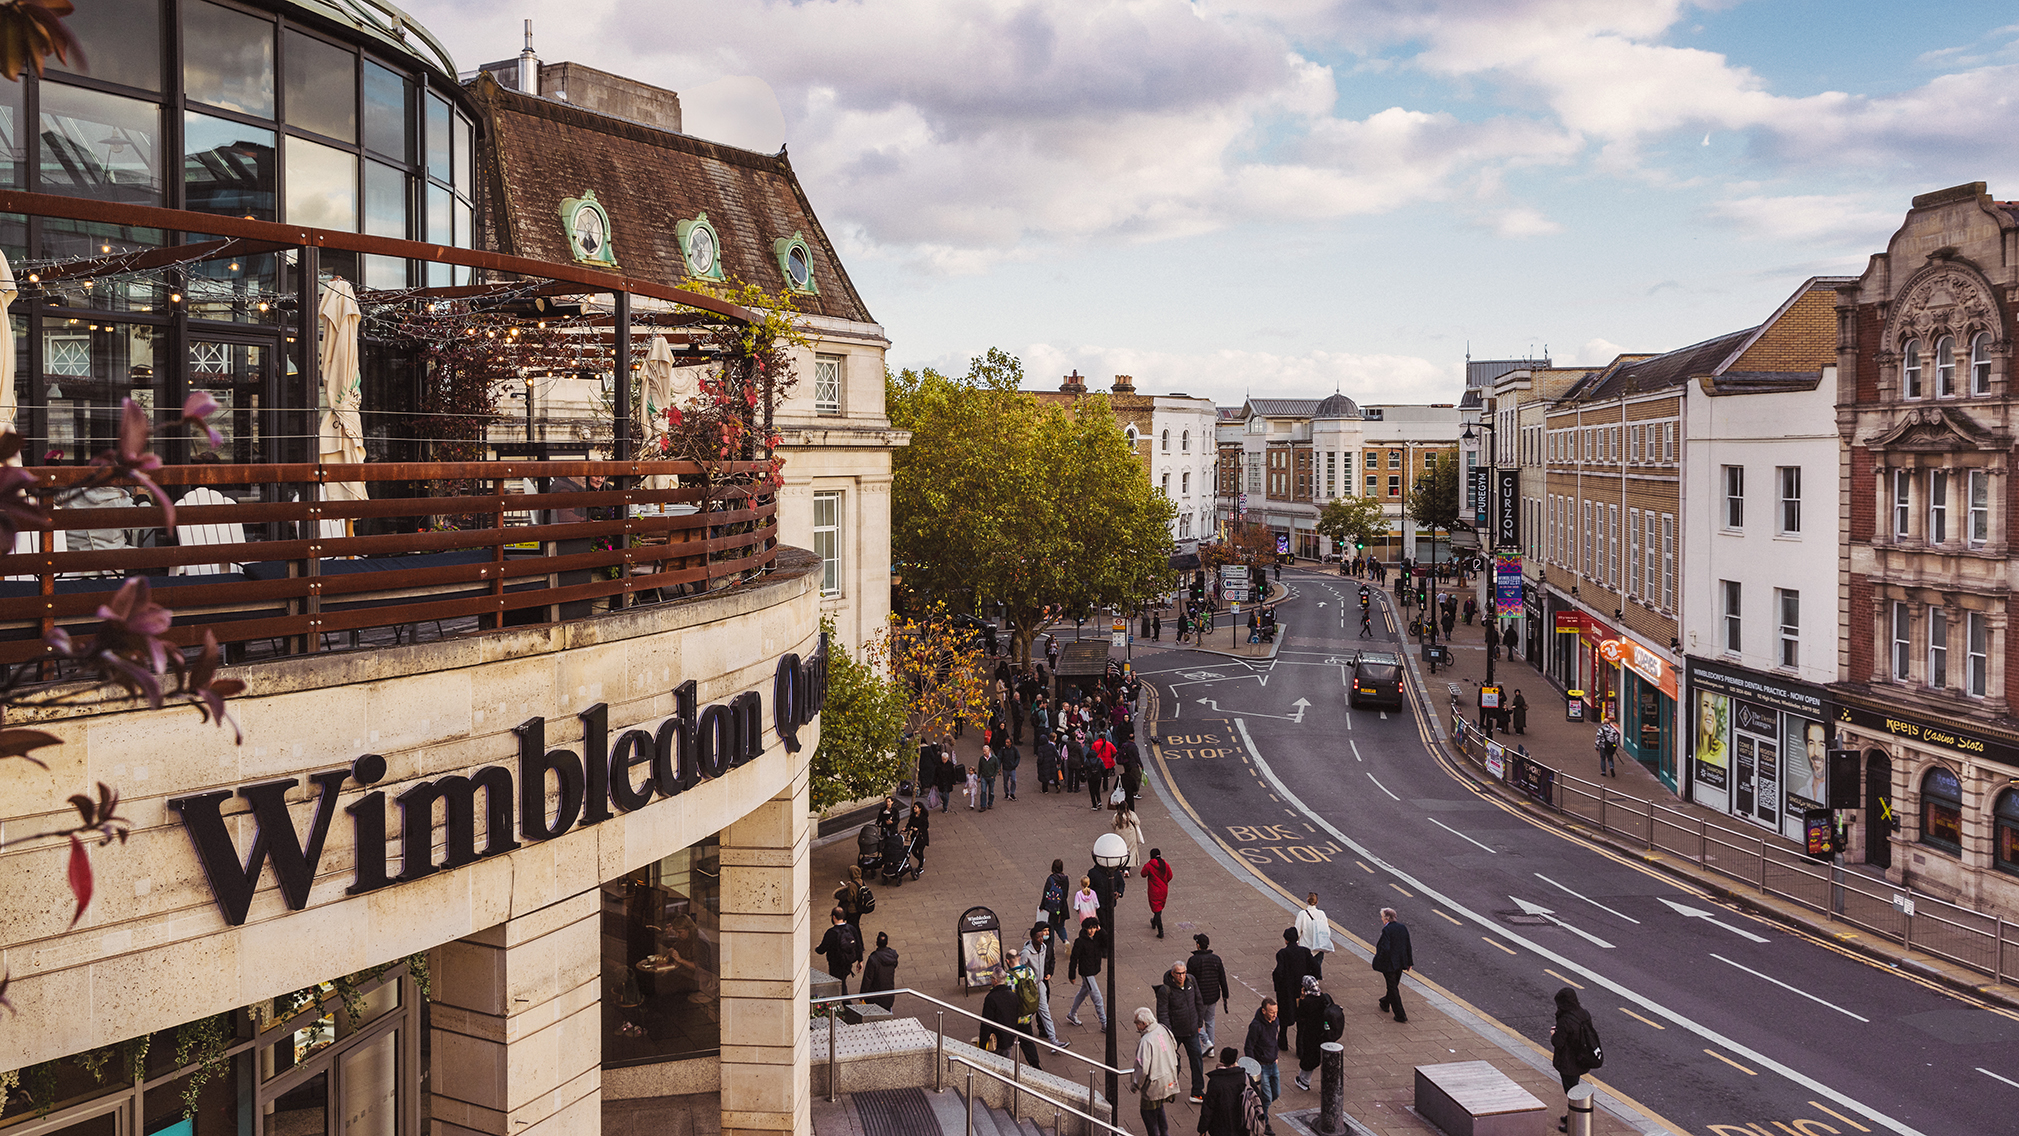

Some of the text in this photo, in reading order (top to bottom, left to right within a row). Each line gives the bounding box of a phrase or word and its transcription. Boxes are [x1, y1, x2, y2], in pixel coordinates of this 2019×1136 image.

[1478, 474, 1486, 513] PUREGYM
[1503, 478, 1514, 538] CURZON
[1694, 668, 1724, 682] WIMBLEDON'S
[1724, 675, 1744, 687] PREMIER
[1745, 681, 1763, 692] DENTAL
[1763, 685, 1787, 698] PRACTICE
[1790, 692, 1804, 702] NOW
[1805, 696, 1820, 706] OPEN
[1752, 711, 1776, 724] The Dental
[1167, 734, 1220, 745] BUS
[1923, 728, 1954, 744] Casino
[1957, 737, 1984, 752] Slots
[1164, 748, 1233, 759] STOP
[1937, 774, 1957, 787] Reels
[169, 679, 766, 926] Wimbledon
[1226, 824, 1304, 842] BUS
[1238, 845, 1336, 864] STOP
